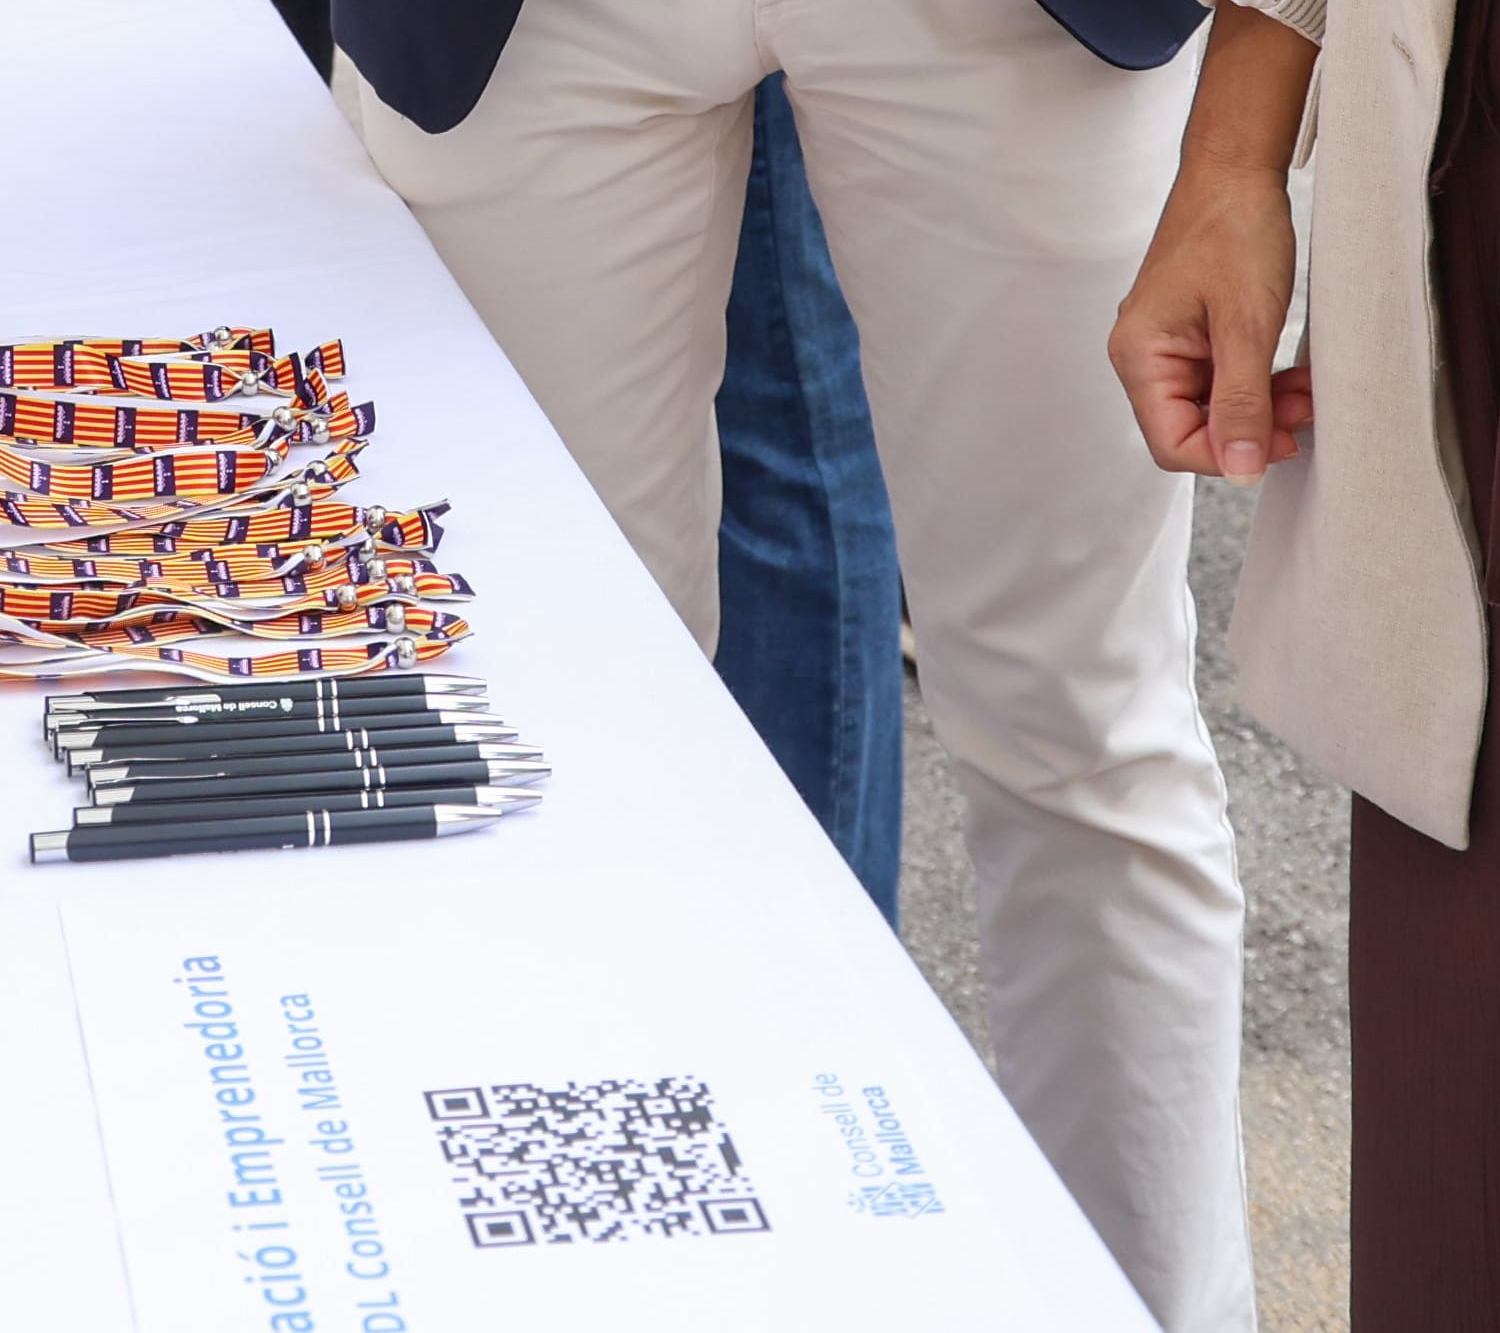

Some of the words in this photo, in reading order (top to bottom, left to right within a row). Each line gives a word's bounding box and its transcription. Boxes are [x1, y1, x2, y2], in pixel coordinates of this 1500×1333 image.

[175, 702, 222, 713] Mallorca
[223, 702, 237, 712] de
[238, 700, 278, 712] Consell
[279, 993, 342, 1110] Mallorca
[172, 955, 285, 1208] Emprenedoria
[810, 1073, 844, 1098] de
[309, 1120, 355, 1154] de
[819, 1102, 884, 1178] Consell
[861, 1086, 926, 1175] Mallorca
[233, 1221, 289, 1233] i
[316, 1163, 390, 1280] Consell
